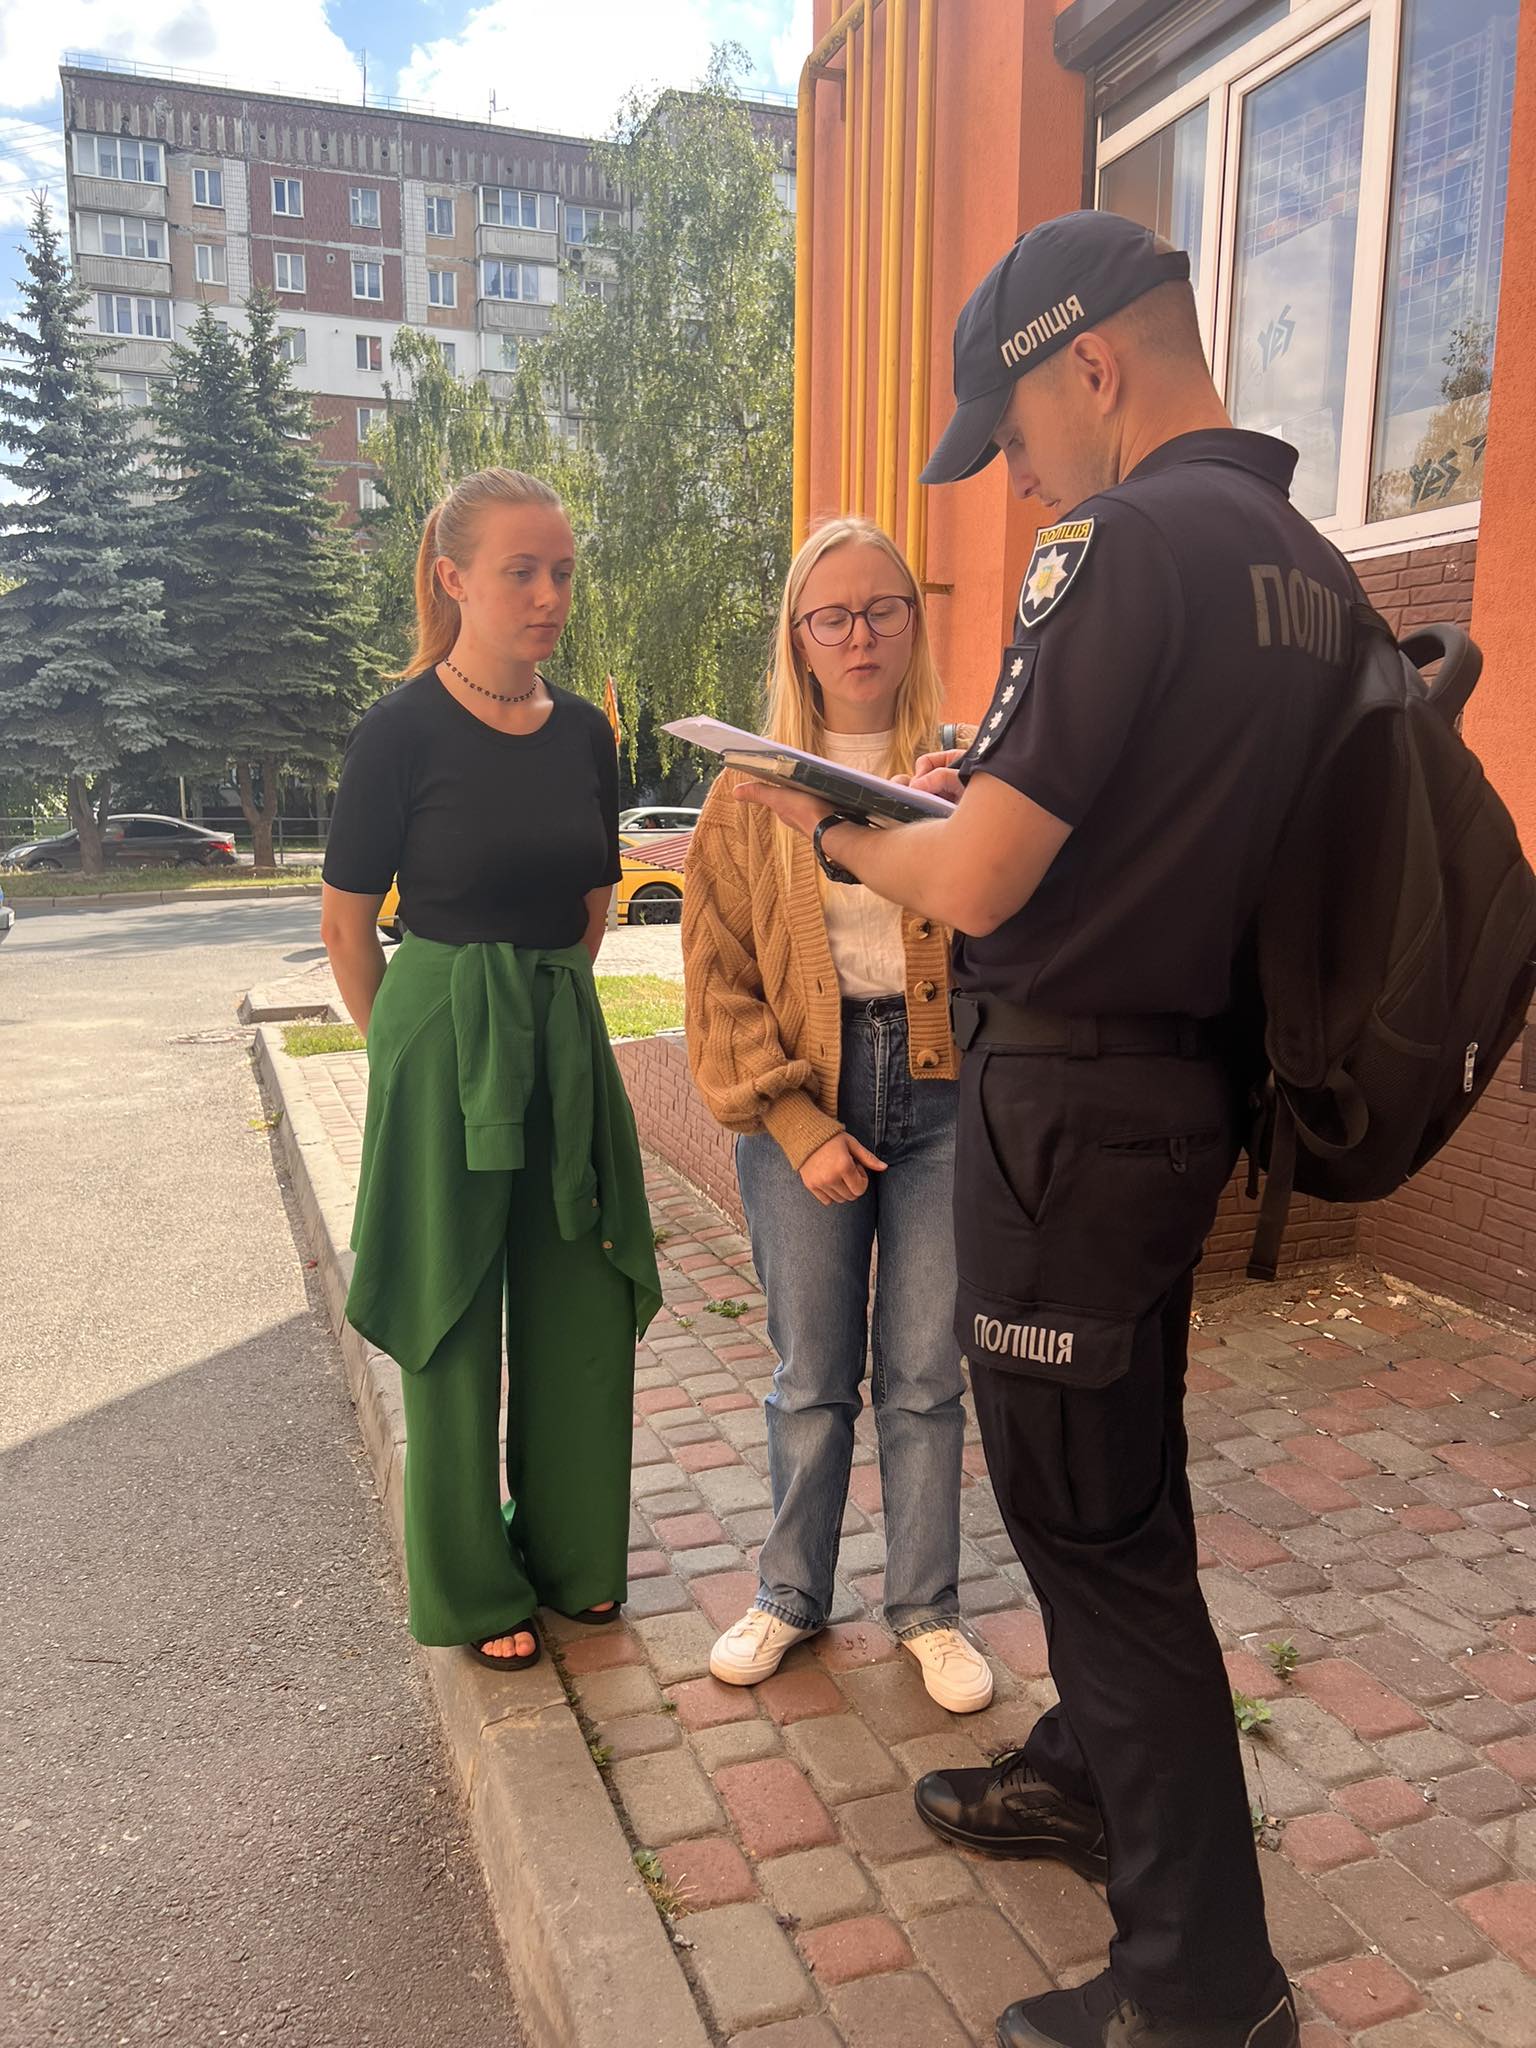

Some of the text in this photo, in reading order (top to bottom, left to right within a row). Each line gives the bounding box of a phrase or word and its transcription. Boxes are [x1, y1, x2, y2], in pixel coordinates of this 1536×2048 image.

[1001, 294, 1085, 368] ПОЛІЦІЯ
[1040, 523, 1091, 545] ПОЛІЦІЯ
[1249, 564, 1345, 664] ПОЛІ
[975, 1313, 1074, 1365] ПОЛІЦІЯ
